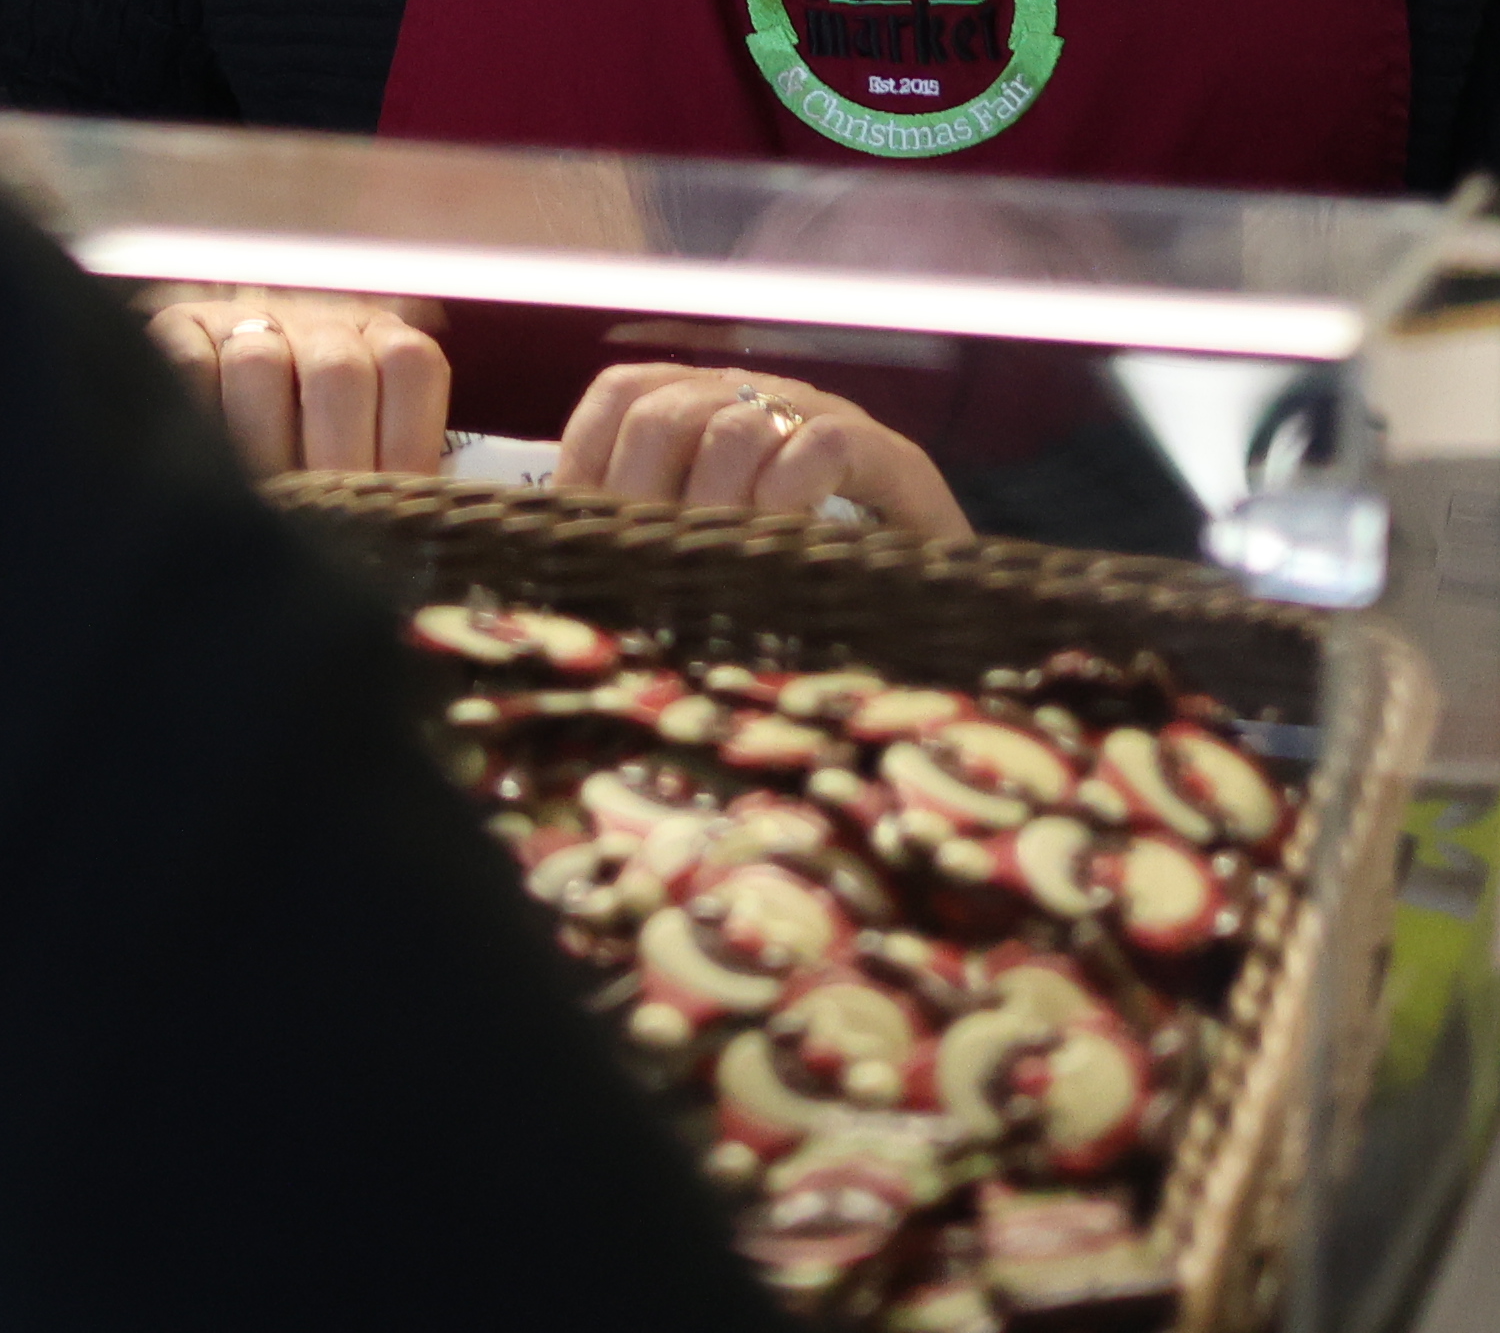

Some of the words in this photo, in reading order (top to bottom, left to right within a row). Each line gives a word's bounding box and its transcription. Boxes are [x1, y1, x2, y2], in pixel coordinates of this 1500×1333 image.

[777, 65, 808, 97] &
[803, 89, 973, 151] Christmas
[967, 72, 1035, 134] Fair
